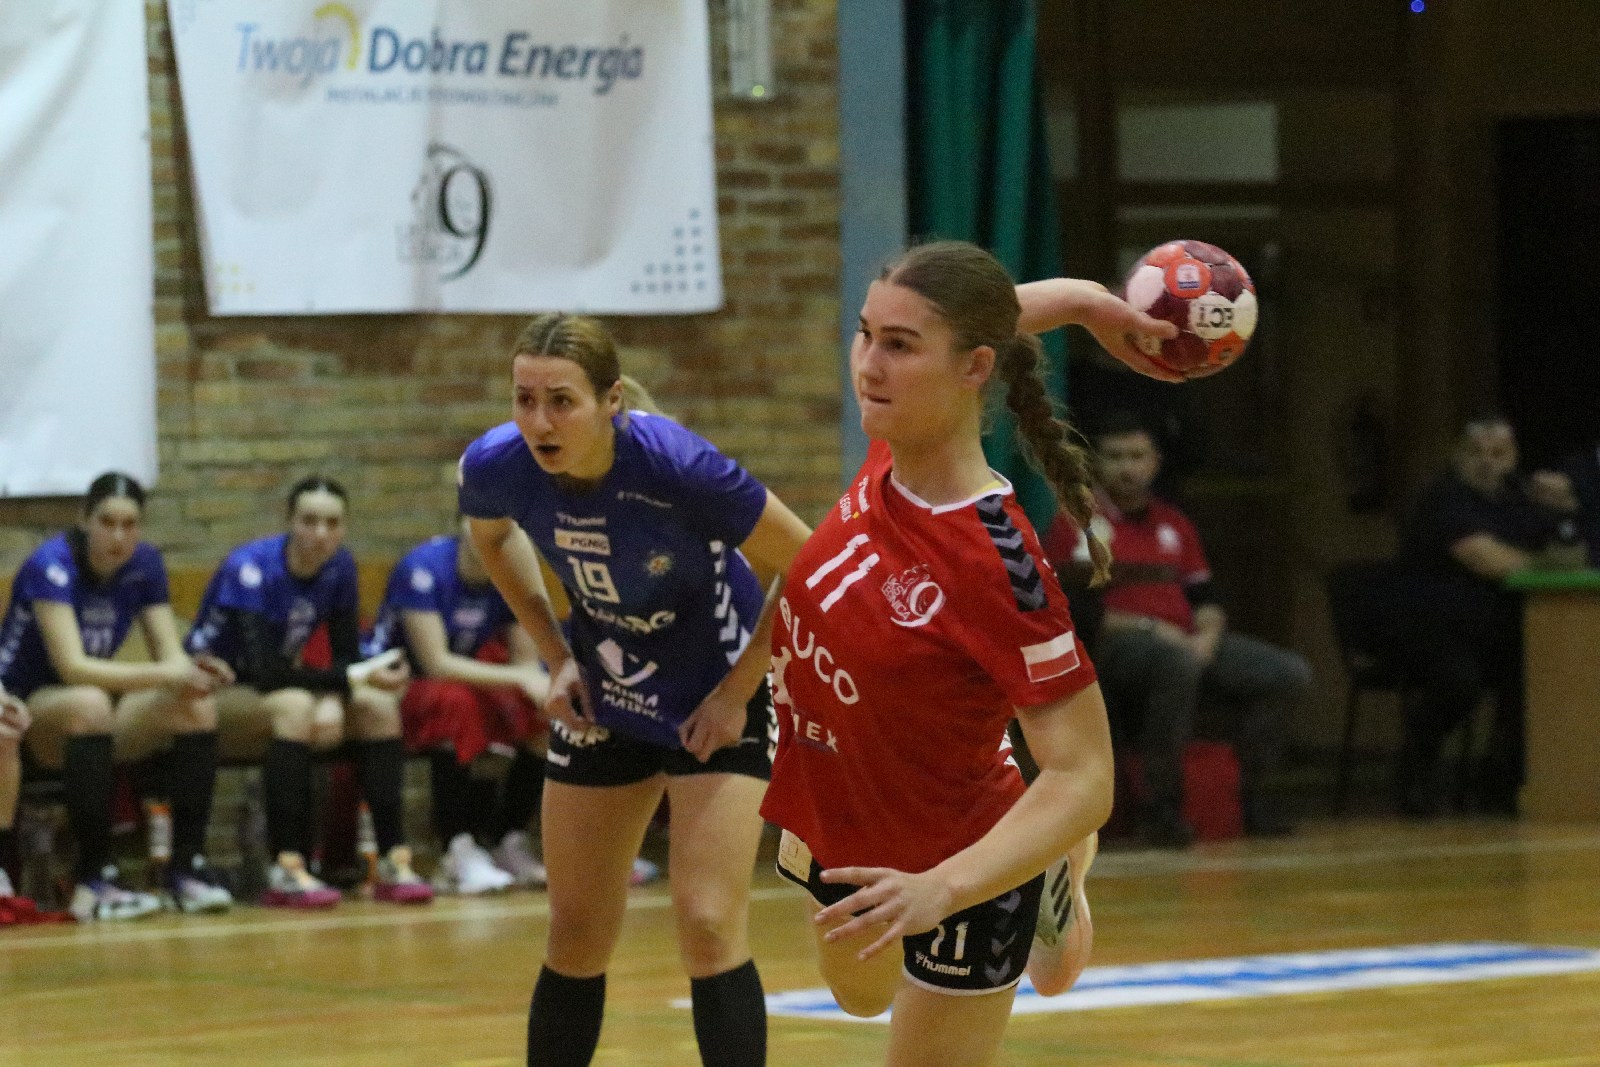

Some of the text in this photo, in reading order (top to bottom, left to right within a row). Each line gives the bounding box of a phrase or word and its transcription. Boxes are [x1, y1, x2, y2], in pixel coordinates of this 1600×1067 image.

[235, 23, 645, 96] Twoja Dobra Energia
[567, 555, 620, 604] 19
[805, 533, 881, 613] 11
[920, 954, 972, 977] hummel
